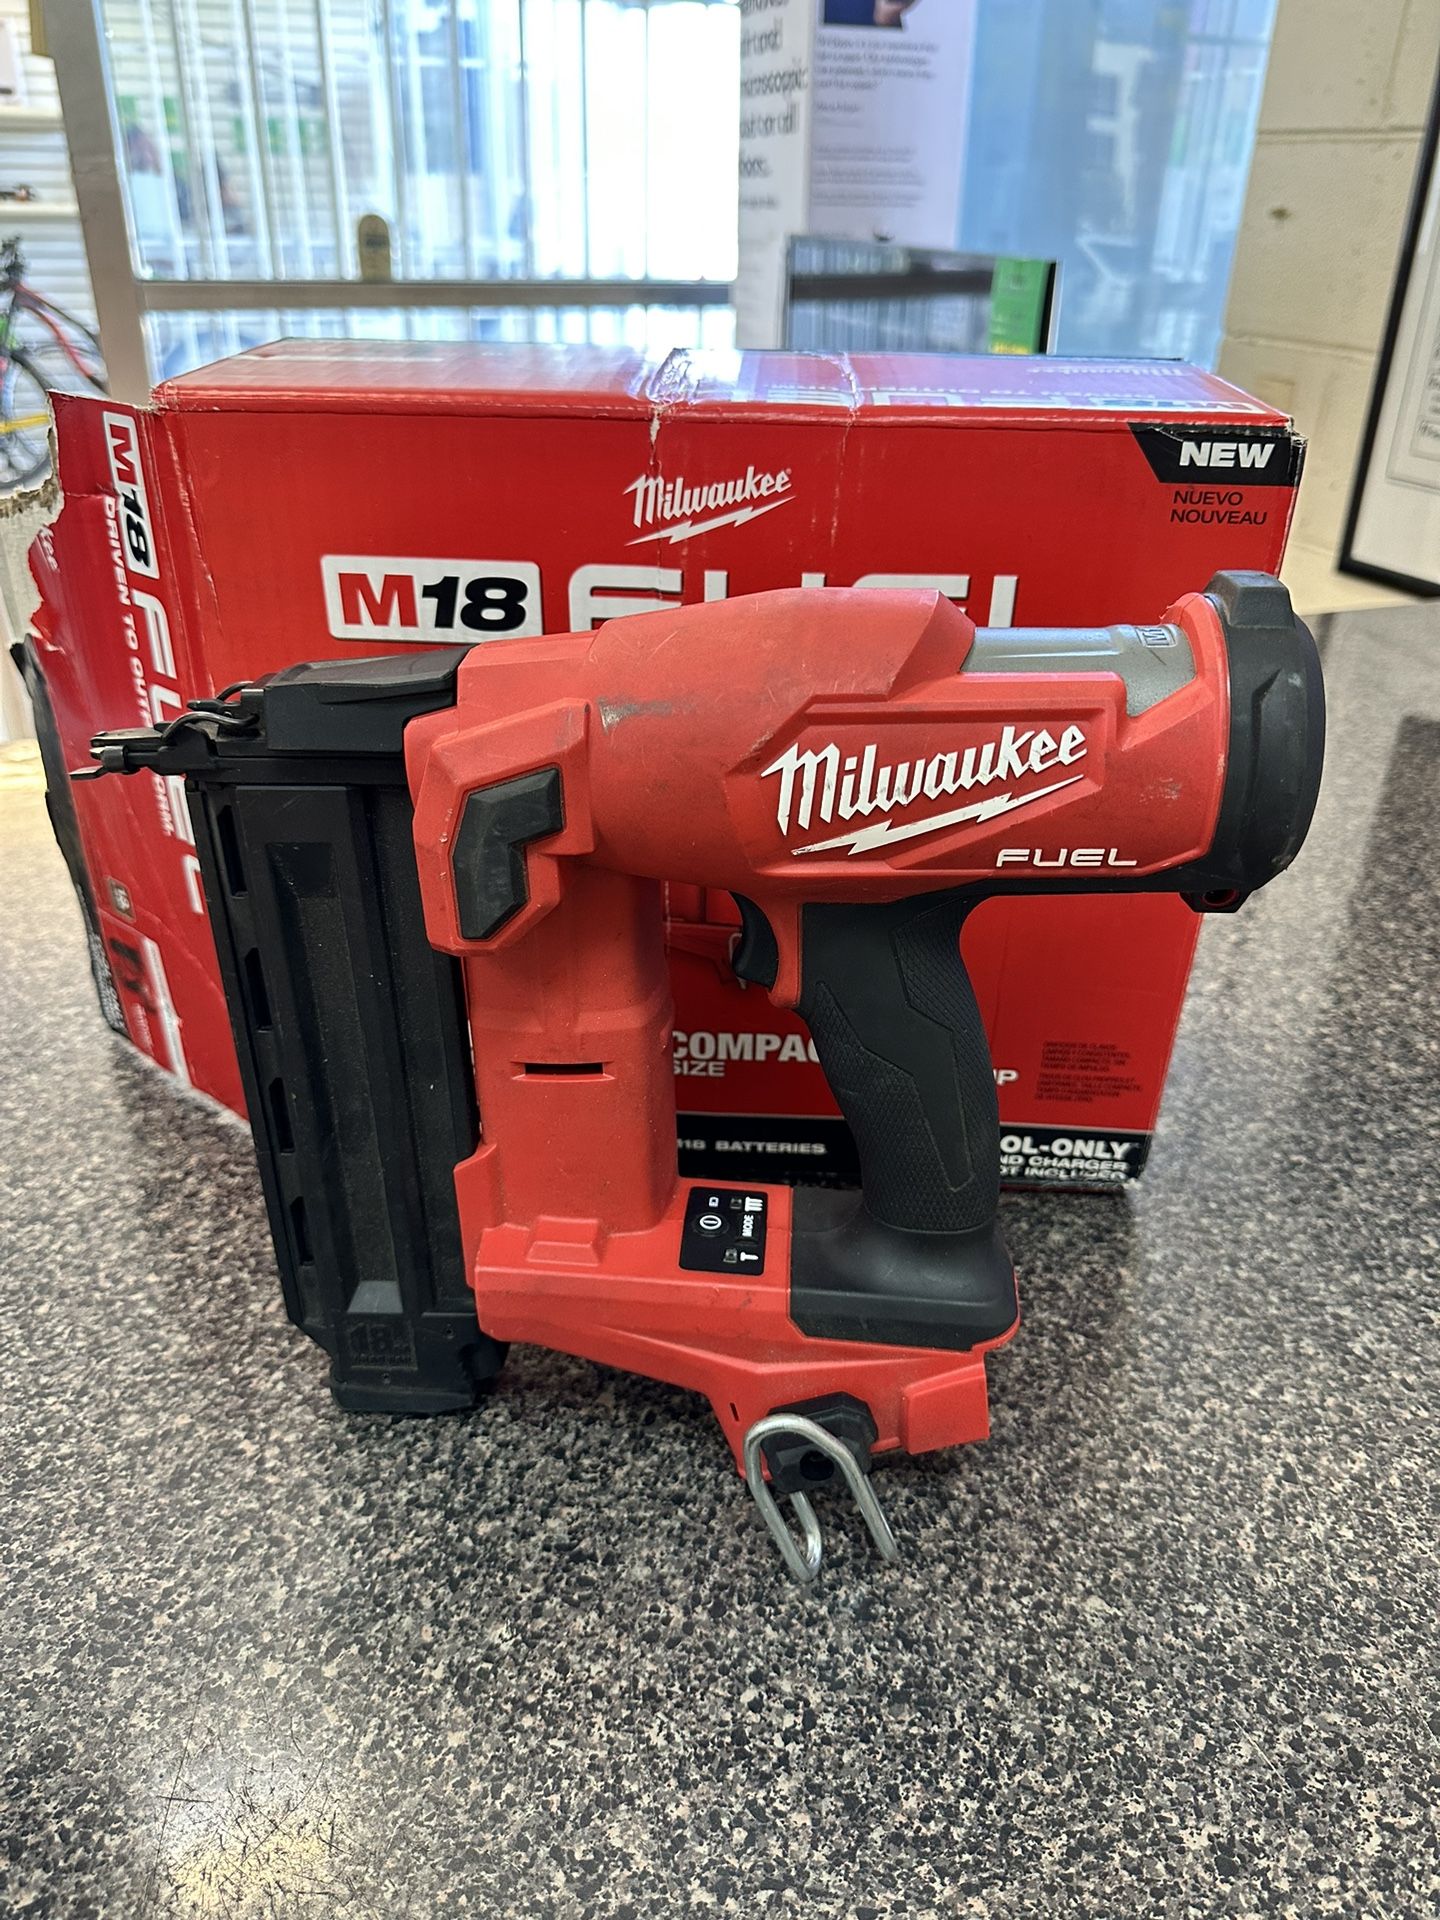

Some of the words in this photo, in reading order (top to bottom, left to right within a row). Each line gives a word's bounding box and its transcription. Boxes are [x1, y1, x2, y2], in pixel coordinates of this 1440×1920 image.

[1179, 441, 1275, 469] NEW
[111, 424, 150, 569] M18
[622, 465, 793, 529] Milwaukee
[1173, 490, 1243, 506] NUEVO
[1170, 508, 1268, 526] NOUVEAU
[103, 497, 131, 606] DRIVEN
[121, 612, 139, 651] TO
[336, 571, 529, 632] M18
[761, 724, 1088, 837] Milwaukee
[995, 847, 1138, 868] FUEL
[673, 1060, 726, 1078] SIZE
[715, 1139, 828, 1156] BATTERIES
[1028, 1155, 1130, 1172] CHARGER
[741, 1214, 754, 1239] MODE
